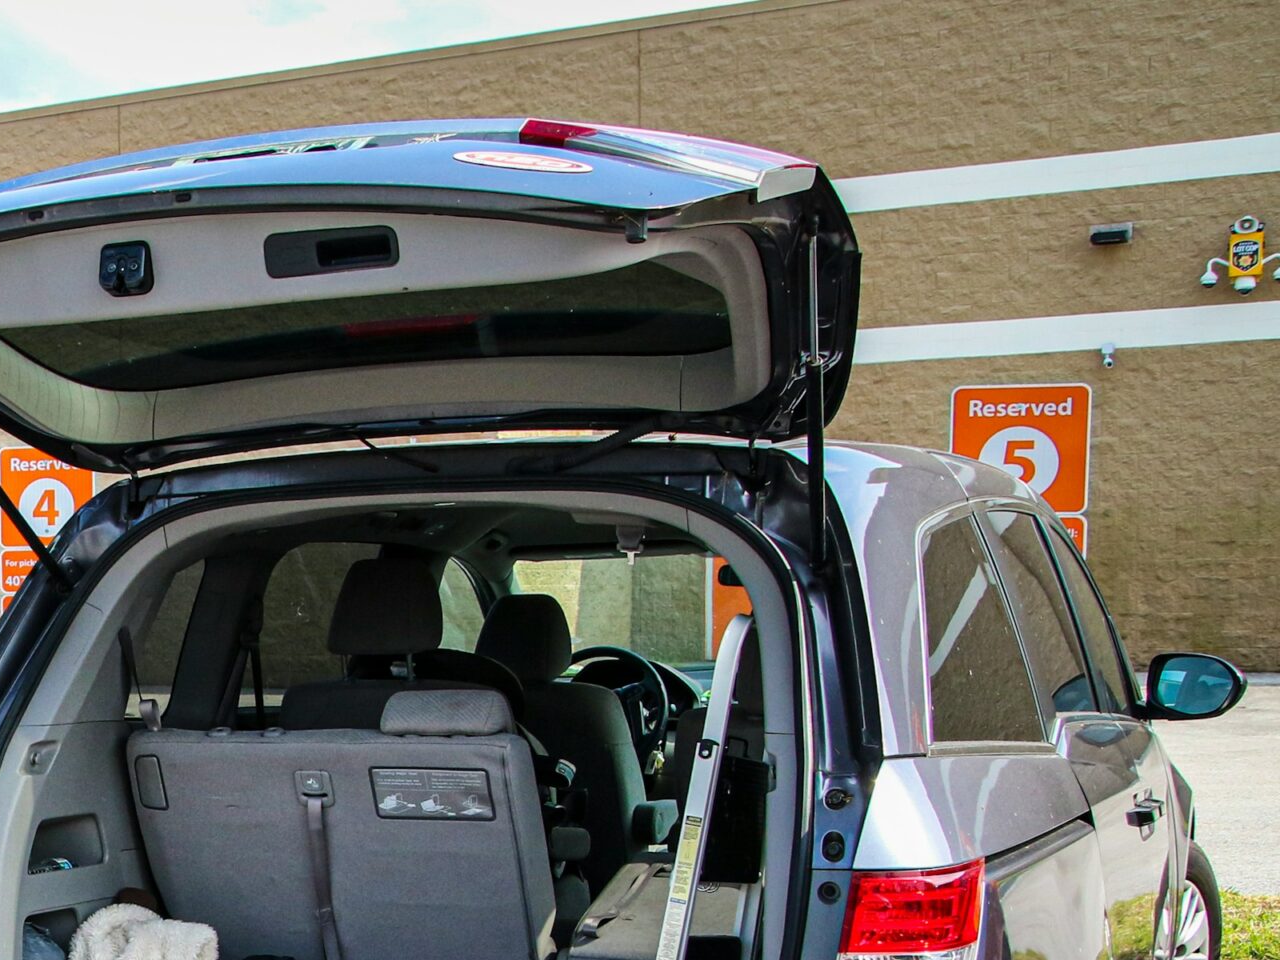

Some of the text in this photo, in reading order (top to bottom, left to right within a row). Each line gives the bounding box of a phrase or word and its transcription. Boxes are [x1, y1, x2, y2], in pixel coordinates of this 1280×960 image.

[969, 397, 1073, 417] Reserved
[10, 457, 78, 472] Reserve
[1003, 440, 1037, 485] 5
[32, 489, 59, 526] 4
[5, 559, 18, 567] For
